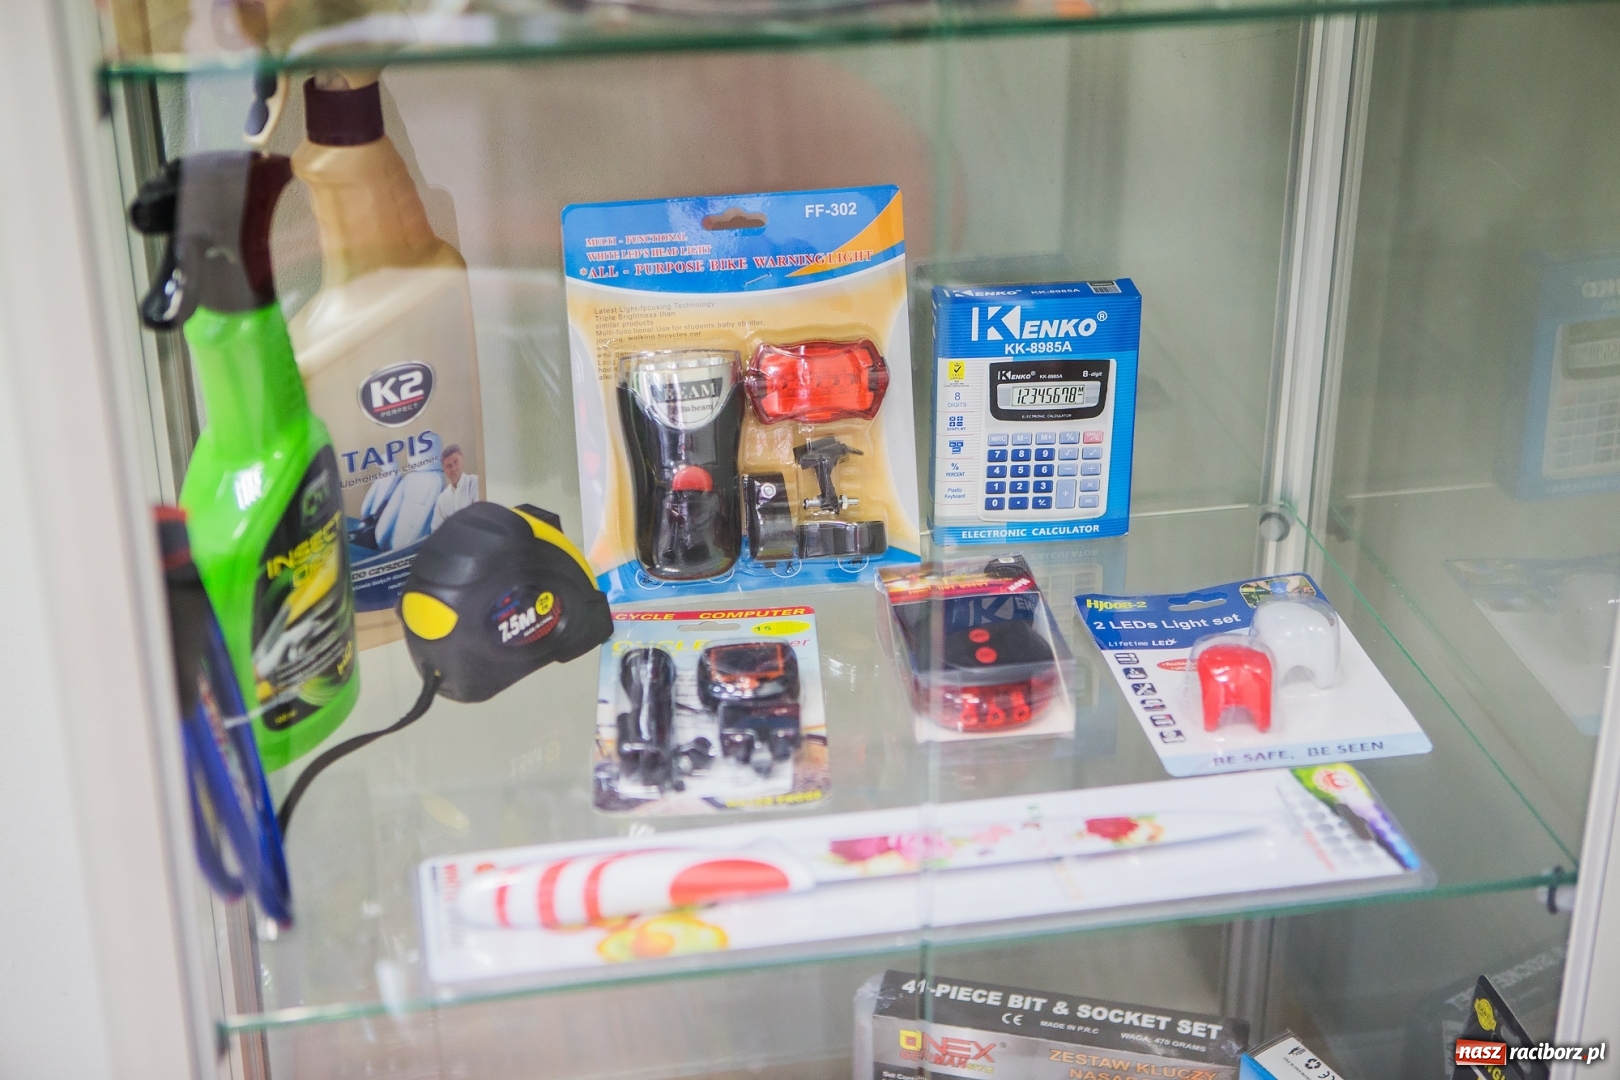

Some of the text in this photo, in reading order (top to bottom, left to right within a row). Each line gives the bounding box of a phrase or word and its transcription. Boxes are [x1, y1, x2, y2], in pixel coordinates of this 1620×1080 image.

[805, 202, 857, 218] FF-302
[585, 236, 617, 247] MULTI
[625, 232, 688, 245] FUNCTIONAL
[586, 245, 712, 262] WHITE LED'S HEAD LIGHT
[635, 261, 704, 276] PURPOSE
[709, 258, 748, 272] BIKE
[753, 253, 825, 268] WARNING
[827, 250, 874, 264] LIGHT
[594, 307, 617, 315] Latest
[674, 301, 715, 310] Technology
[618, 312, 657, 321] Brightness
[622, 320, 654, 329] products
[1004, 341, 1073, 355] KK-8985A
[370, 371, 424, 408] K2
[954, 392, 961, 401] 8
[991, 434, 1006, 442] MRC
[341, 431, 433, 473] TAPIS
[1019, 450, 1025, 458] 8
[1042, 450, 1048, 458] 9
[340, 456, 439, 488] Upholstery cleaner
[1042, 466, 1047, 474] 6
[1040, 482, 1046, 490] 3
[961, 524, 1100, 539] ELECTRONIC CALCULATOR
[615, 608, 806, 620] CYCLE COMPUTER
[1094, 613, 1242, 630] 2 LEDs Light set
[1108, 640, 1149, 648] Lifetime
[1214, 755, 1237, 766] BE
[1308, 747, 1331, 757] BE
[1337, 741, 1384, 754] SEEN
[1007, 994, 1048, 1012] BIT
[1052, 1001, 1070, 1016] &
[1076, 1004, 1172, 1031] SOCKET
[1176, 1020, 1223, 1040] SET
[1040, 1020, 1065, 1030] MADE
[1066, 1023, 1076, 1031] IN
[1172, 1040, 1207, 1053] GRAMS
[966, 1063, 996, 1074] STYLE
[1049, 1049, 1217, 1080] ZESTAW KLUCZY
